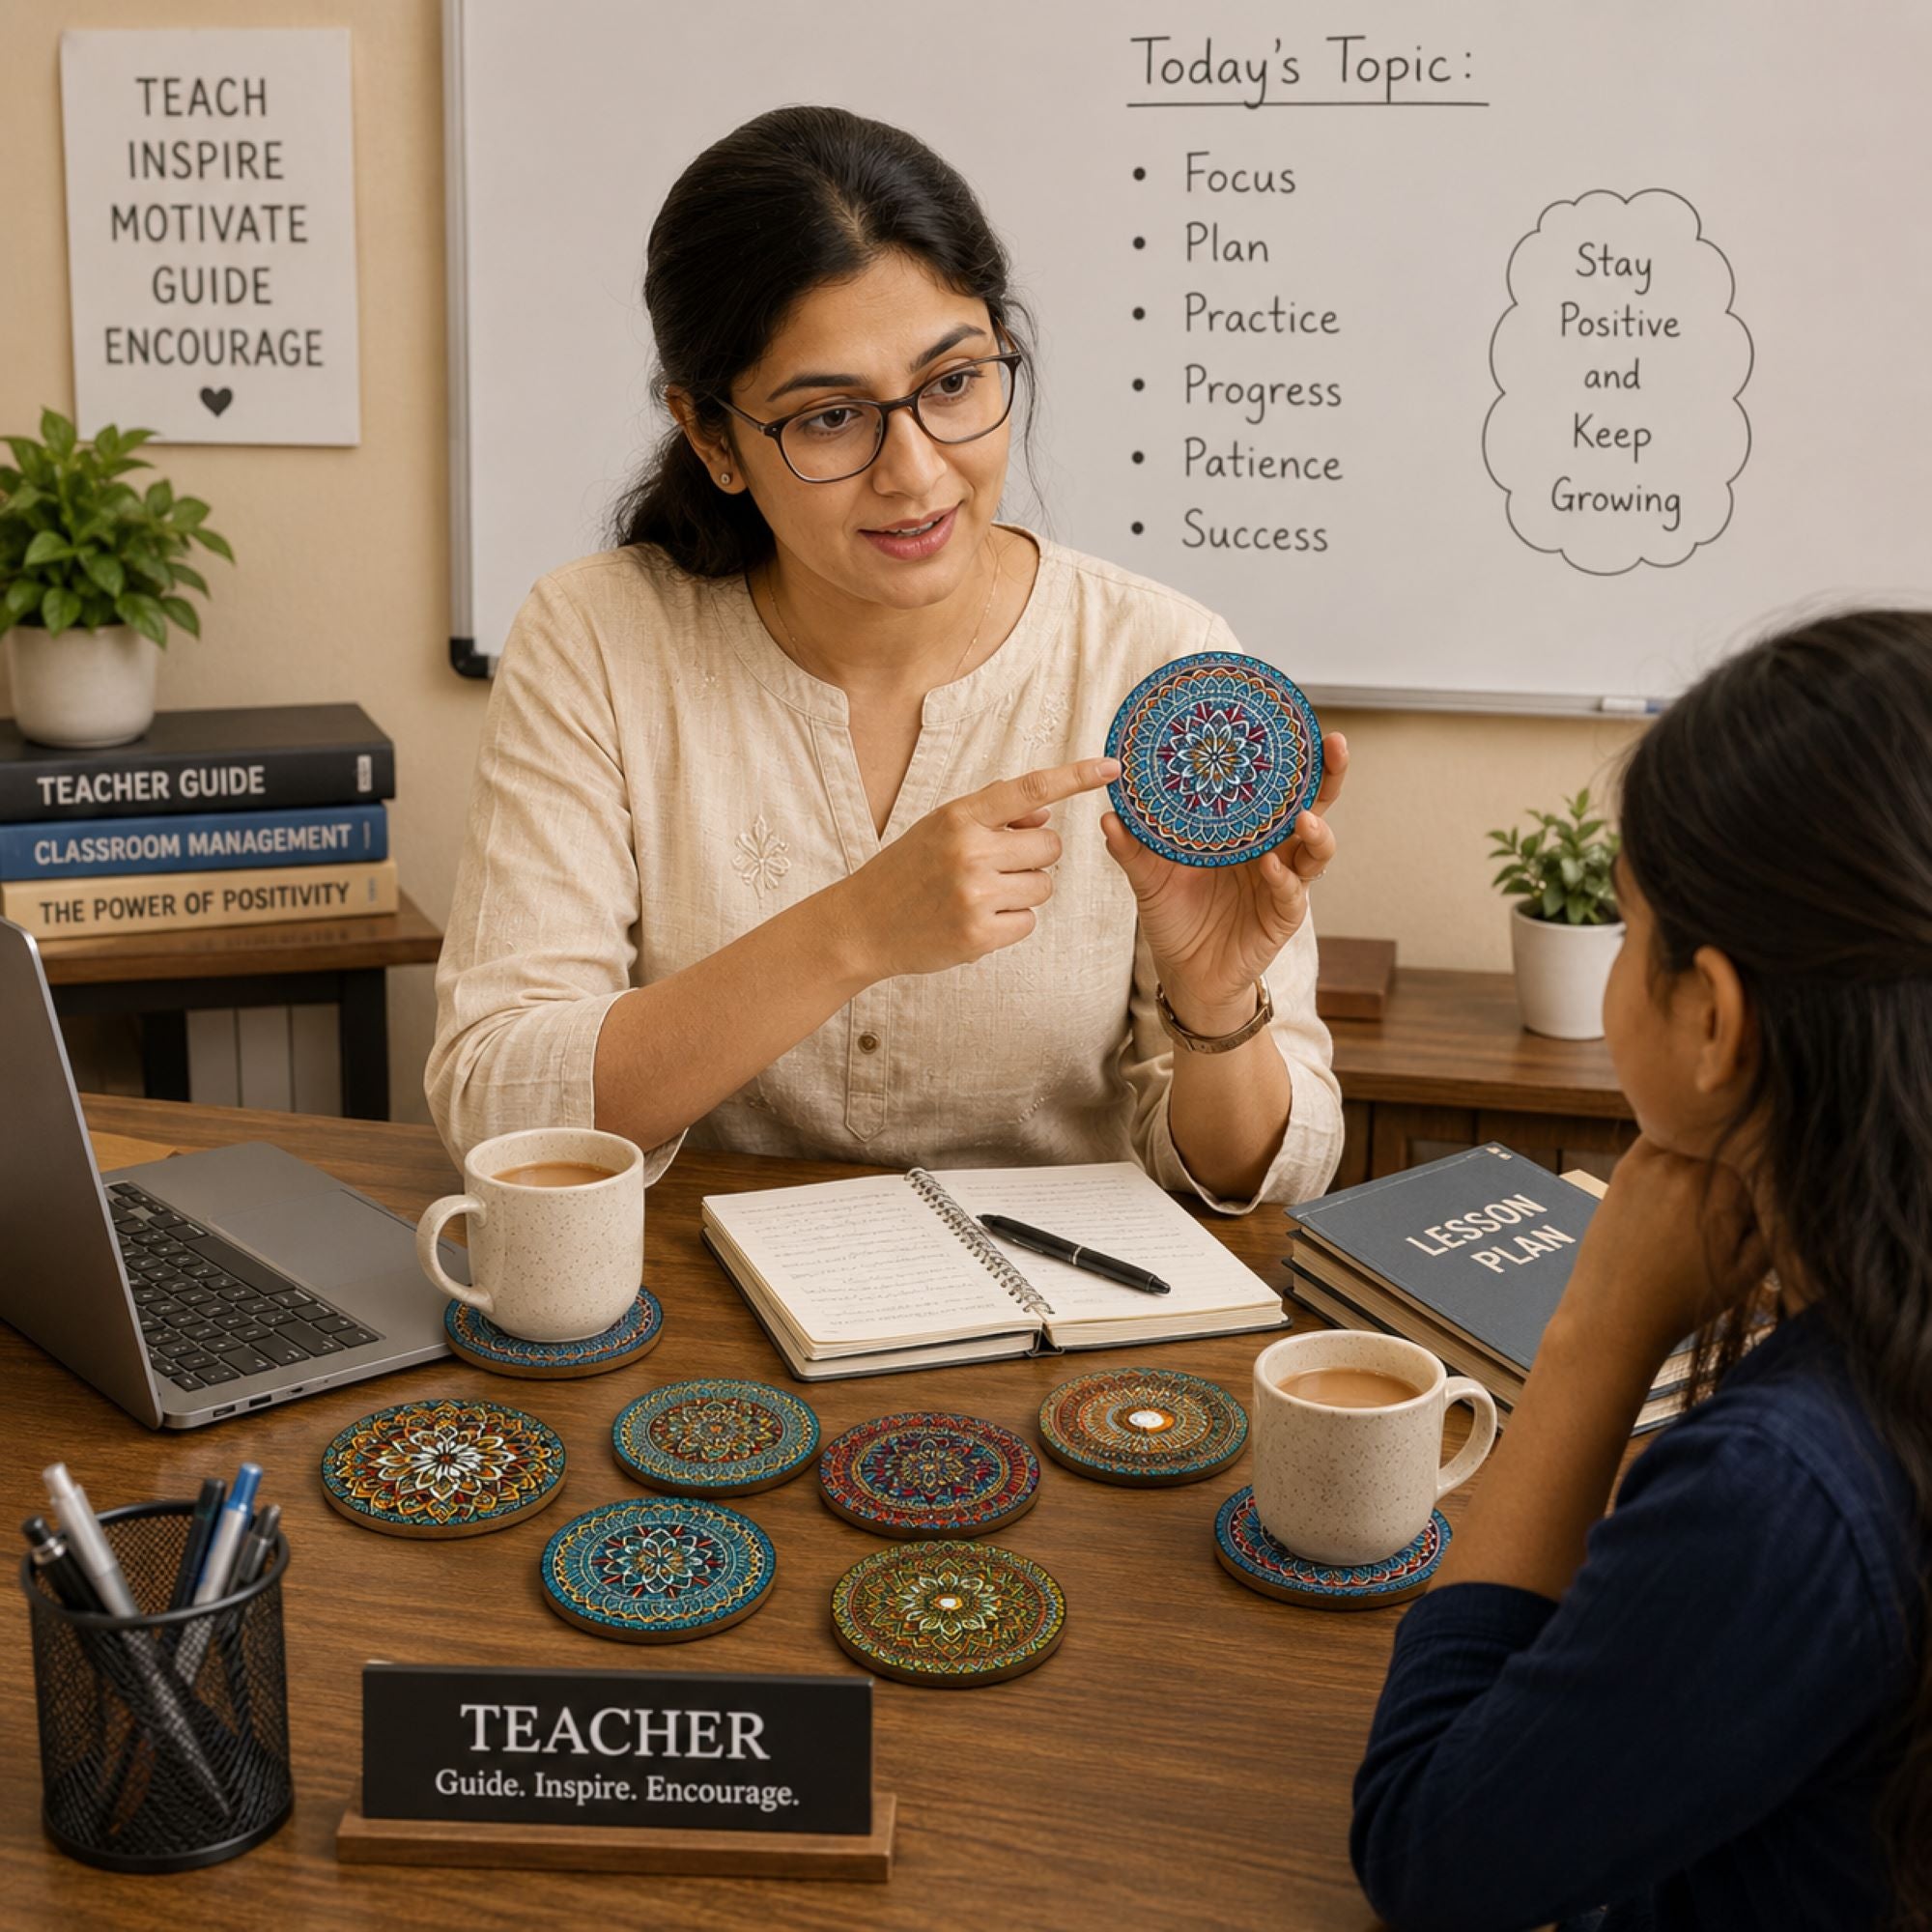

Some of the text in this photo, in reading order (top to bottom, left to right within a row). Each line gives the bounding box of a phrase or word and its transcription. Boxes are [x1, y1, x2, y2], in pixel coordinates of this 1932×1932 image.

[1130, 37, 1300, 109] Today's
[135, 77, 268, 117] TEACH
[128, 141, 284, 180] INSPIRE
[1184, 152, 1296, 194] Focus
[111, 205, 308, 242] MOTIVATE
[1184, 222, 1269, 263] Plan
[152, 267, 272, 304] GUIDE
[1575, 242, 1653, 296] Stay
[1184, 292, 1341, 334] Practice
[1559, 301, 1682, 338] Positive
[104, 327, 324, 366] ENCOURAGE
[1184, 364, 1343, 425] Progress
[1583, 358, 1641, 390] and
[1184, 438, 1345, 481] Patience
[1573, 413, 1652, 464] Keep
[1550, 477, 1682, 532] Growing
[1181, 508, 1329, 553] Success
[37, 765, 267, 806] TEACHER GUIDE
[33, 833, 182, 866] CLASSROOM
[187, 823, 353, 857] MANAGEMENT
[39, 900, 85, 924] THE
[93, 895, 177, 920] POWER
[184, 891, 213, 914] OF
[222, 882, 351, 911] POSITIVITY
[1406, 1194, 1548, 1256] LESSON
[1470, 1225, 1577, 1274] PLAN
[460, 1703, 770, 1760] TEACHER
[436, 1769, 800, 1812] Guide. Inspire. Encourage.
